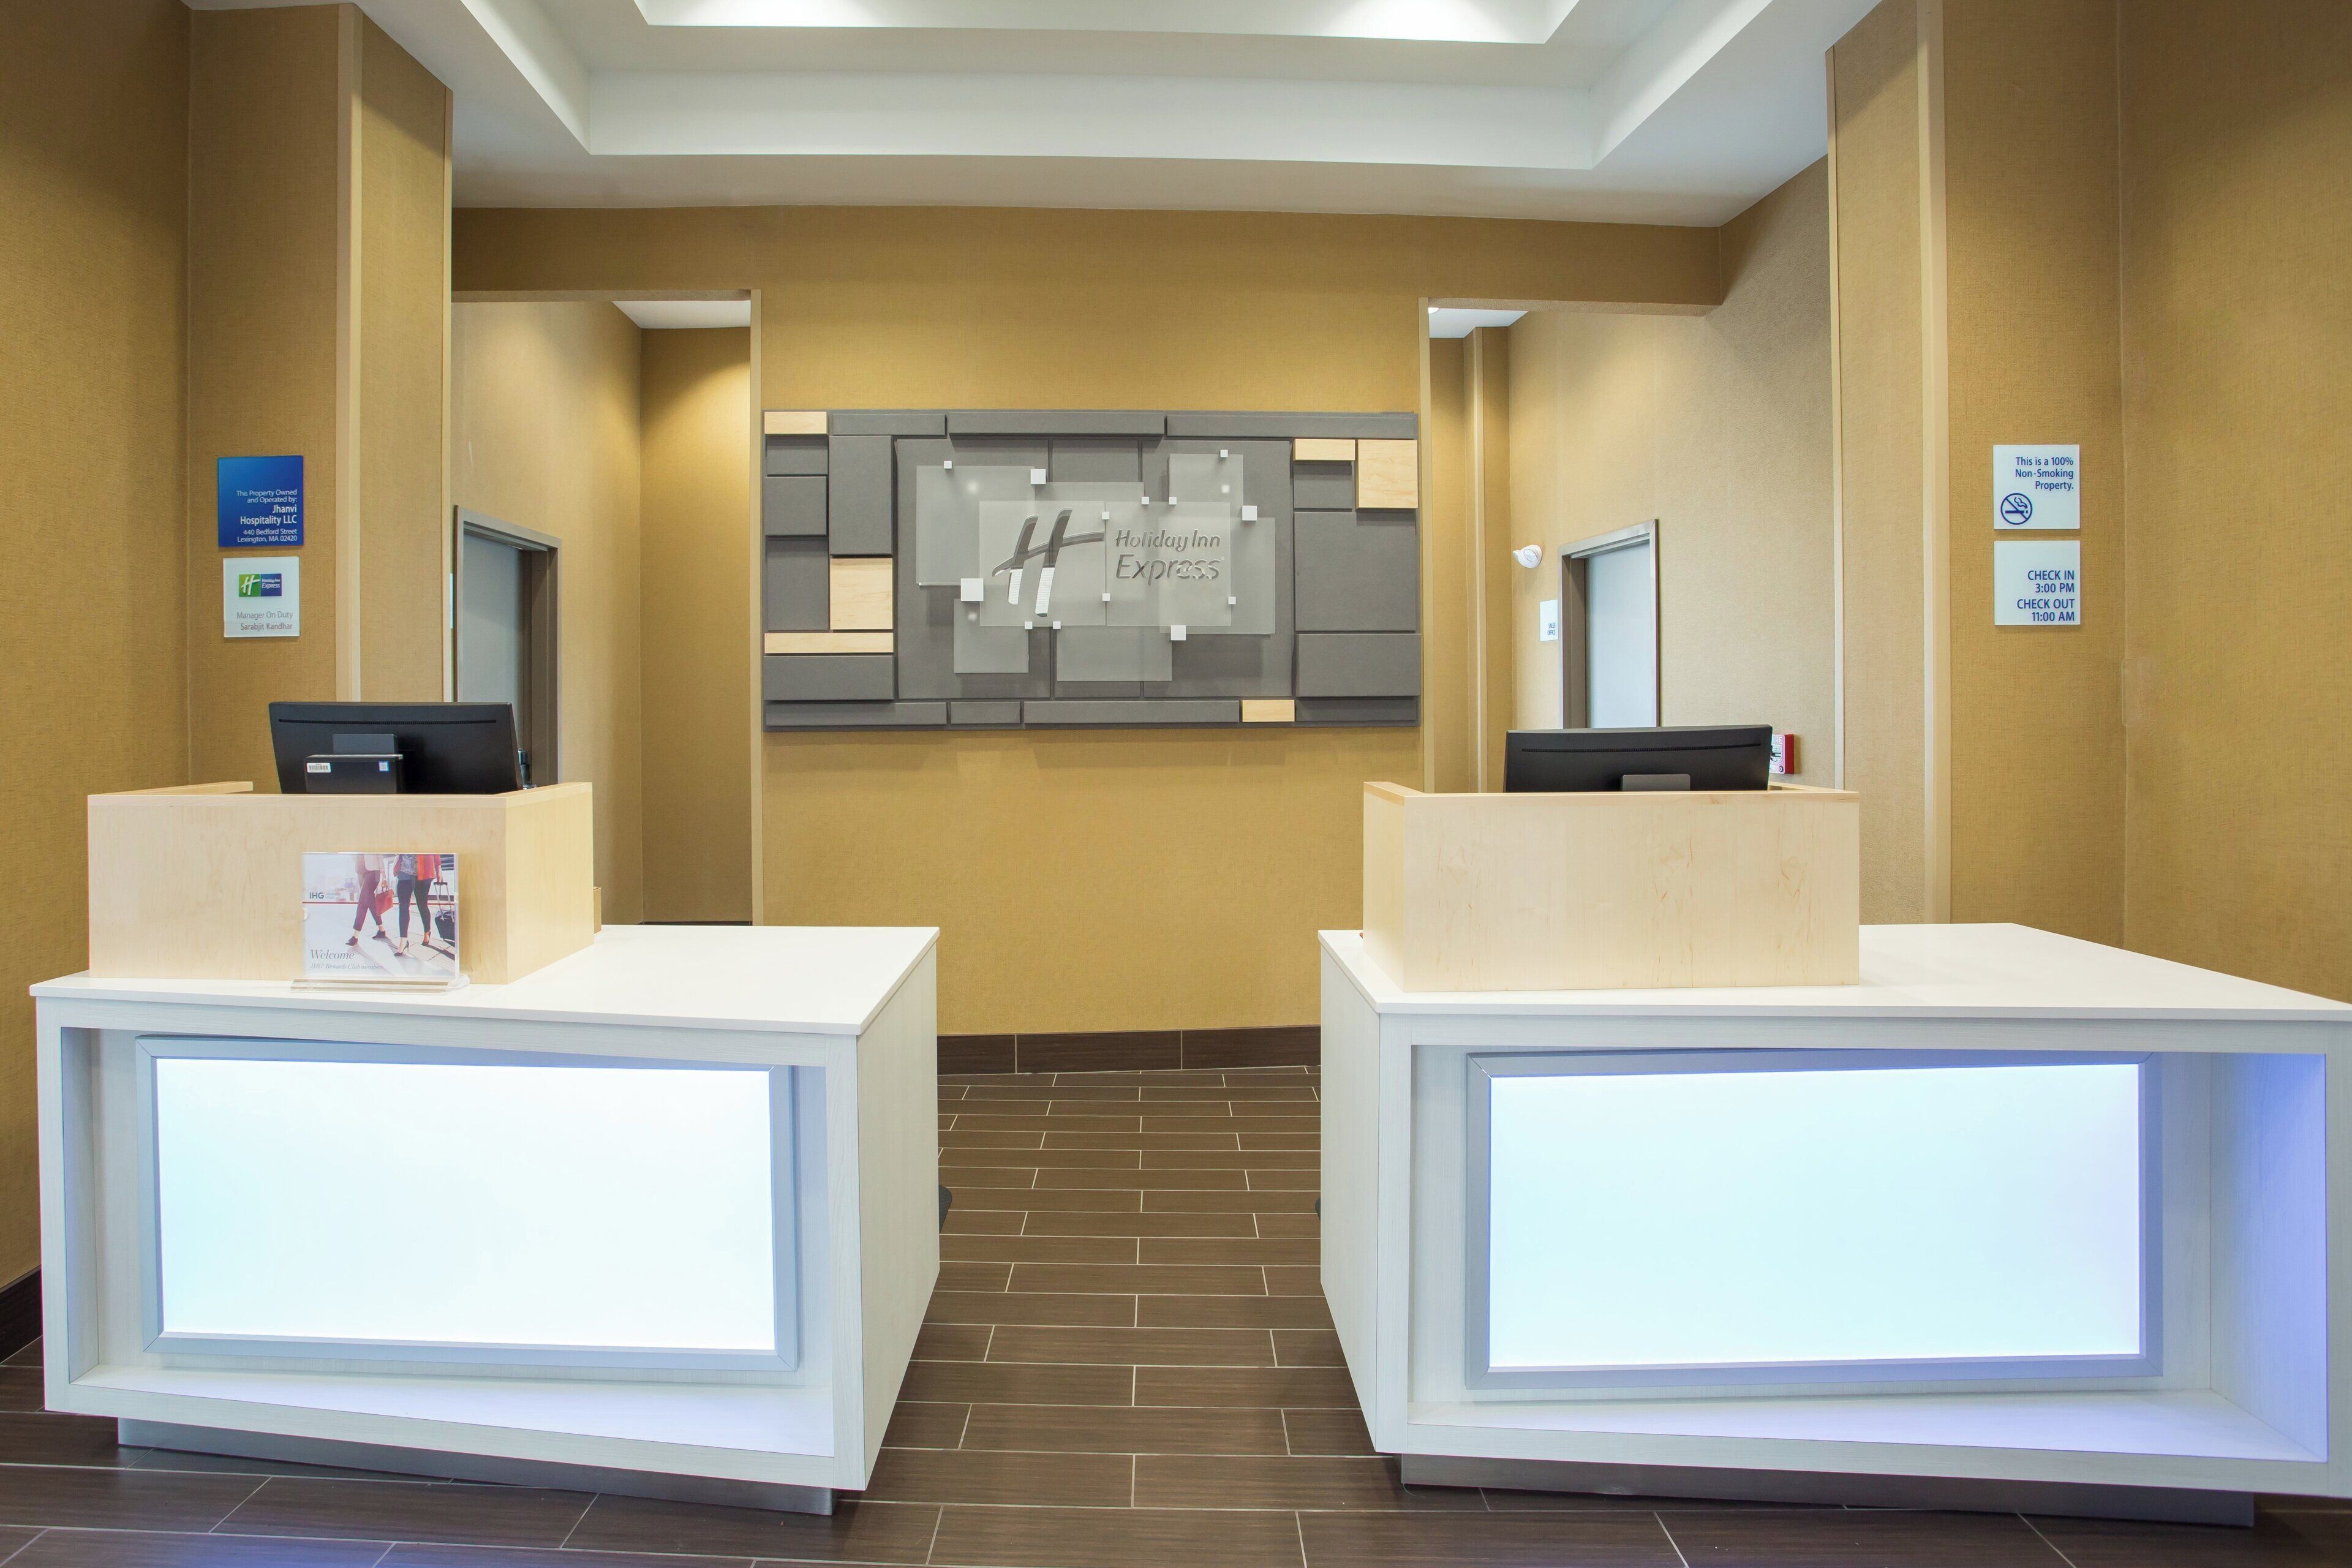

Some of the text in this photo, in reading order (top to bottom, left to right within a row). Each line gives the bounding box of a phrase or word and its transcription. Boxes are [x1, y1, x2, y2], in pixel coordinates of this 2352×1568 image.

[2015, 456, 2032, 466] This
[2035, 457, 2041, 466] is
[2051, 457, 2073, 466] 100%
[2035, 481, 2074, 491] Property.
[273, 505, 297, 513] Jhanvi
[240, 515, 297, 526] Hospitality LLC
[1115, 529, 1221, 552] Holiday Inn
[1116, 553, 1221, 586] Express
[2027, 570, 2075, 581] CHECK IN
[2035, 583, 2075, 593] 3:00 PM
[2017, 598, 2075, 609] CHECK OUT
[2032, 611, 2075, 622] 11:00 AM
[241, 623, 265, 631] Sarabjit
[1772, 736, 1783, 744] IRE
[311, 949, 355, 960] Welcome
